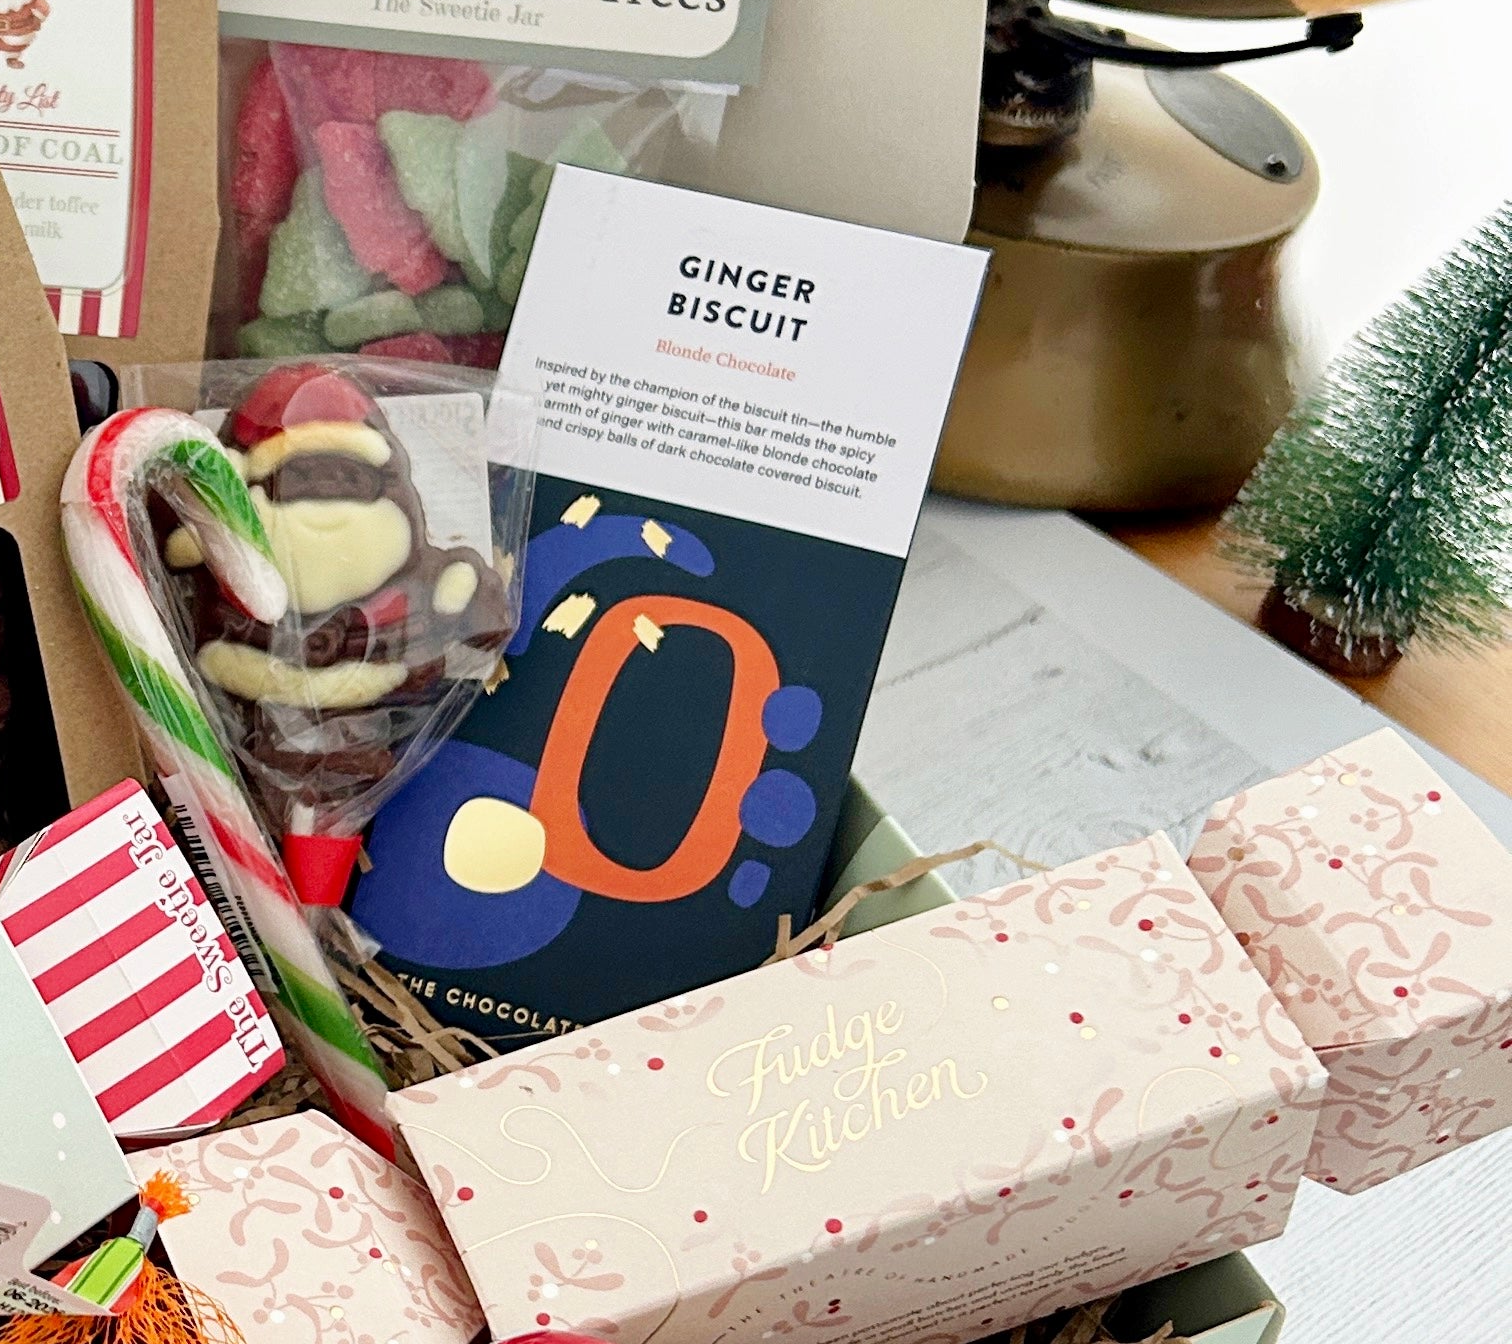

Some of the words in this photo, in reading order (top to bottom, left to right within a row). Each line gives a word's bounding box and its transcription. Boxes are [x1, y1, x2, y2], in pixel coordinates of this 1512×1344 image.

[507, 3, 544, 28] Jar
[17, 83, 60, 117] List
[40, 139, 124, 165] COAL
[49, 194, 100, 215] toffee
[679, 256, 816, 303] GINGER
[668, 293, 808, 342] BISCUIT
[656, 338, 712, 364] Blonde
[715, 352, 796, 382] Chocolate
[535, 357, 587, 378] Inspired
[590, 368, 606, 384] by
[609, 373, 631, 387] the
[633, 380, 698, 402] champion
[702, 394, 716, 406] of
[719, 396, 739, 411] the
[743, 401, 788, 422] biscuit
[845, 425, 897, 448] humble
[544, 380, 566, 393] yet
[568, 384, 613, 405] mighty
[616, 395, 658, 413] ginger
[745, 421, 767, 436] bar
[771, 428, 811, 447] melds
[814, 439, 836, 453] the
[839, 445, 875, 464] spicy
[565, 421, 604, 441] crispy
[607, 429, 638, 447] balls
[640, 438, 655, 450] of
[657, 441, 687, 458] dark
[689, 449, 754, 473] chocolate
[757, 465, 812, 486] covered
[815, 476, 862, 499] biscuit.
[585, 407, 599, 419] of
[602, 411, 644, 428] ginger
[647, 419, 674, 435] with
[678, 426, 759, 455] caramel-like
[763, 445, 808, 466] blonde
[812, 458, 878, 482] chocolate
[123, 811, 164, 866] Jar
[157, 869, 234, 993] Sweetie
[395, 973, 437, 999] THE
[229, 996, 271, 1068] The
[706, 1000, 905, 1116] Fudge
[737, 1048, 988, 1196] Kitchen
